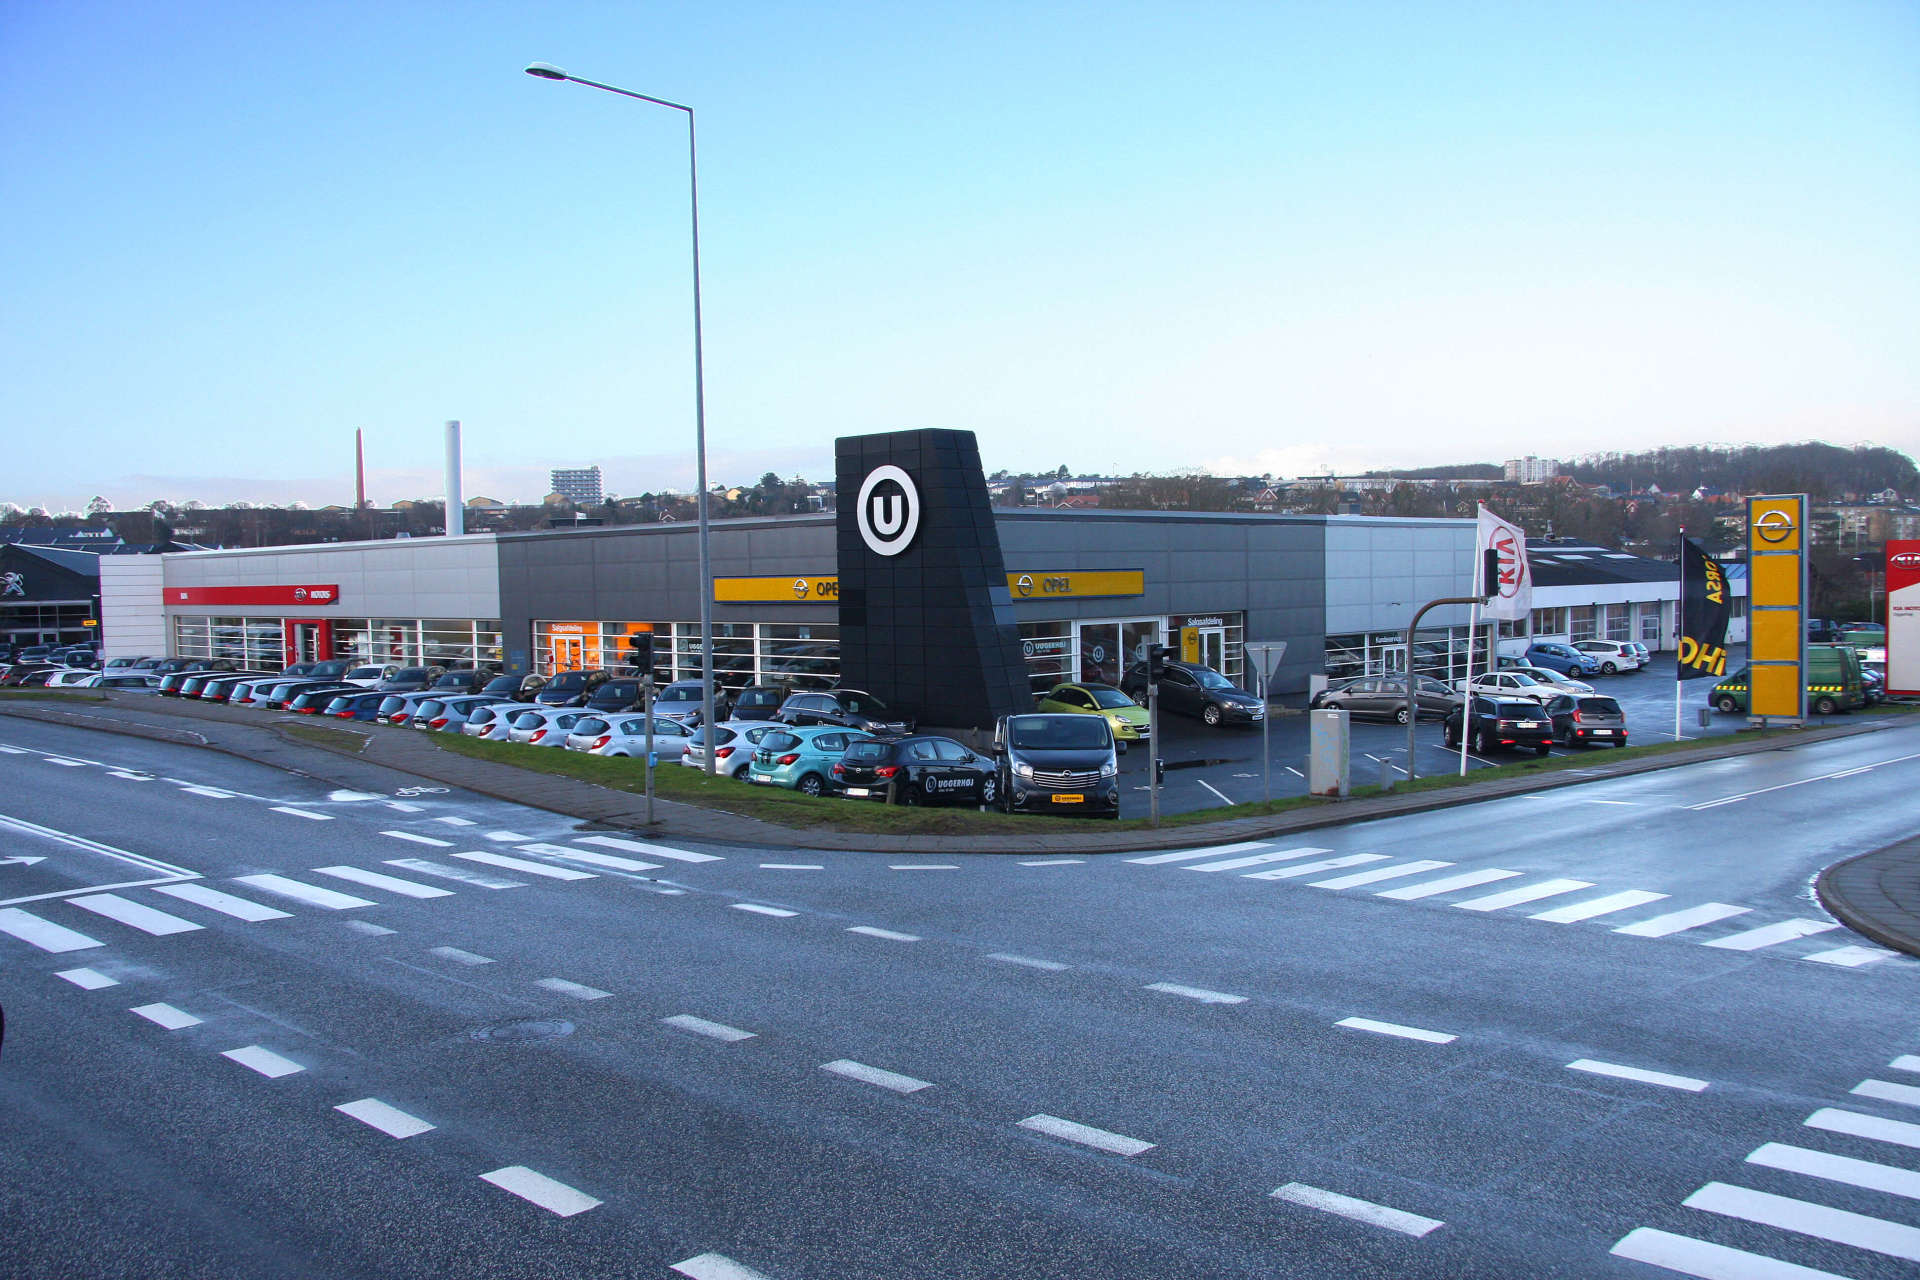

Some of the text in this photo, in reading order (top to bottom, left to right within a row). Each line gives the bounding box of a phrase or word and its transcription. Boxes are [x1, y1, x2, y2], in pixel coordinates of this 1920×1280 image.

[873, 495, 902, 535] U
[1496, 538, 1515, 585] KIA
[816, 582, 839, 596] OPE
[1043, 576, 1073, 593] OPEL
